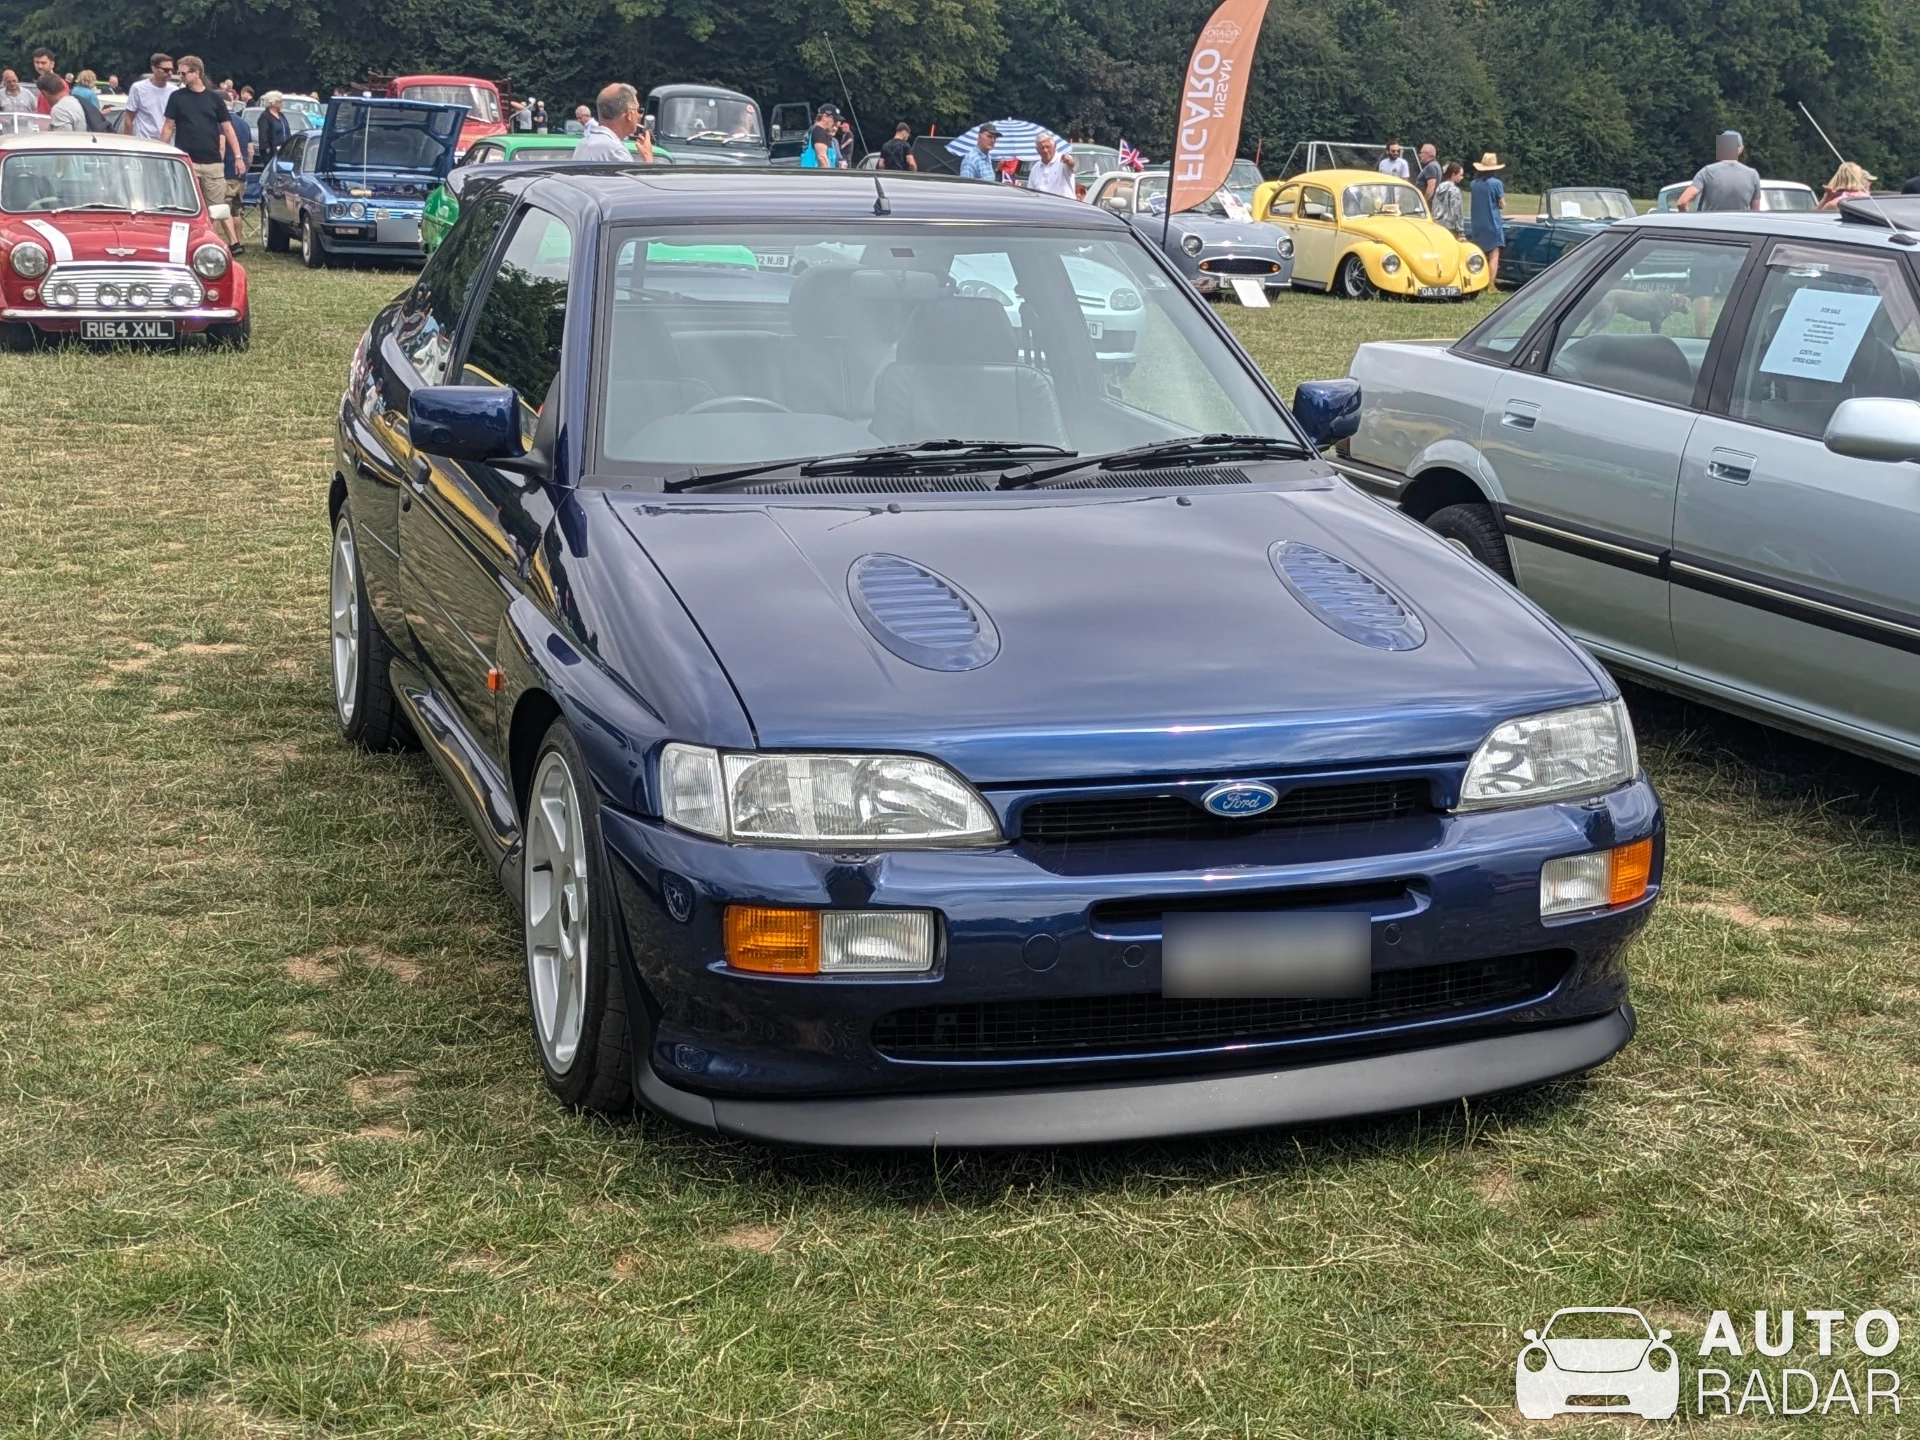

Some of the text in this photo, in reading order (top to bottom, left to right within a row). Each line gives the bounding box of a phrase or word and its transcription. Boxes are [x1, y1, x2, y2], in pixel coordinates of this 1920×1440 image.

[767, 256, 785, 266] NJB
[1421, 287, 1458, 296] OAY 371F
[86, 322, 169, 337] R164 XWL
[1222, 792, 1261, 810] Ford
